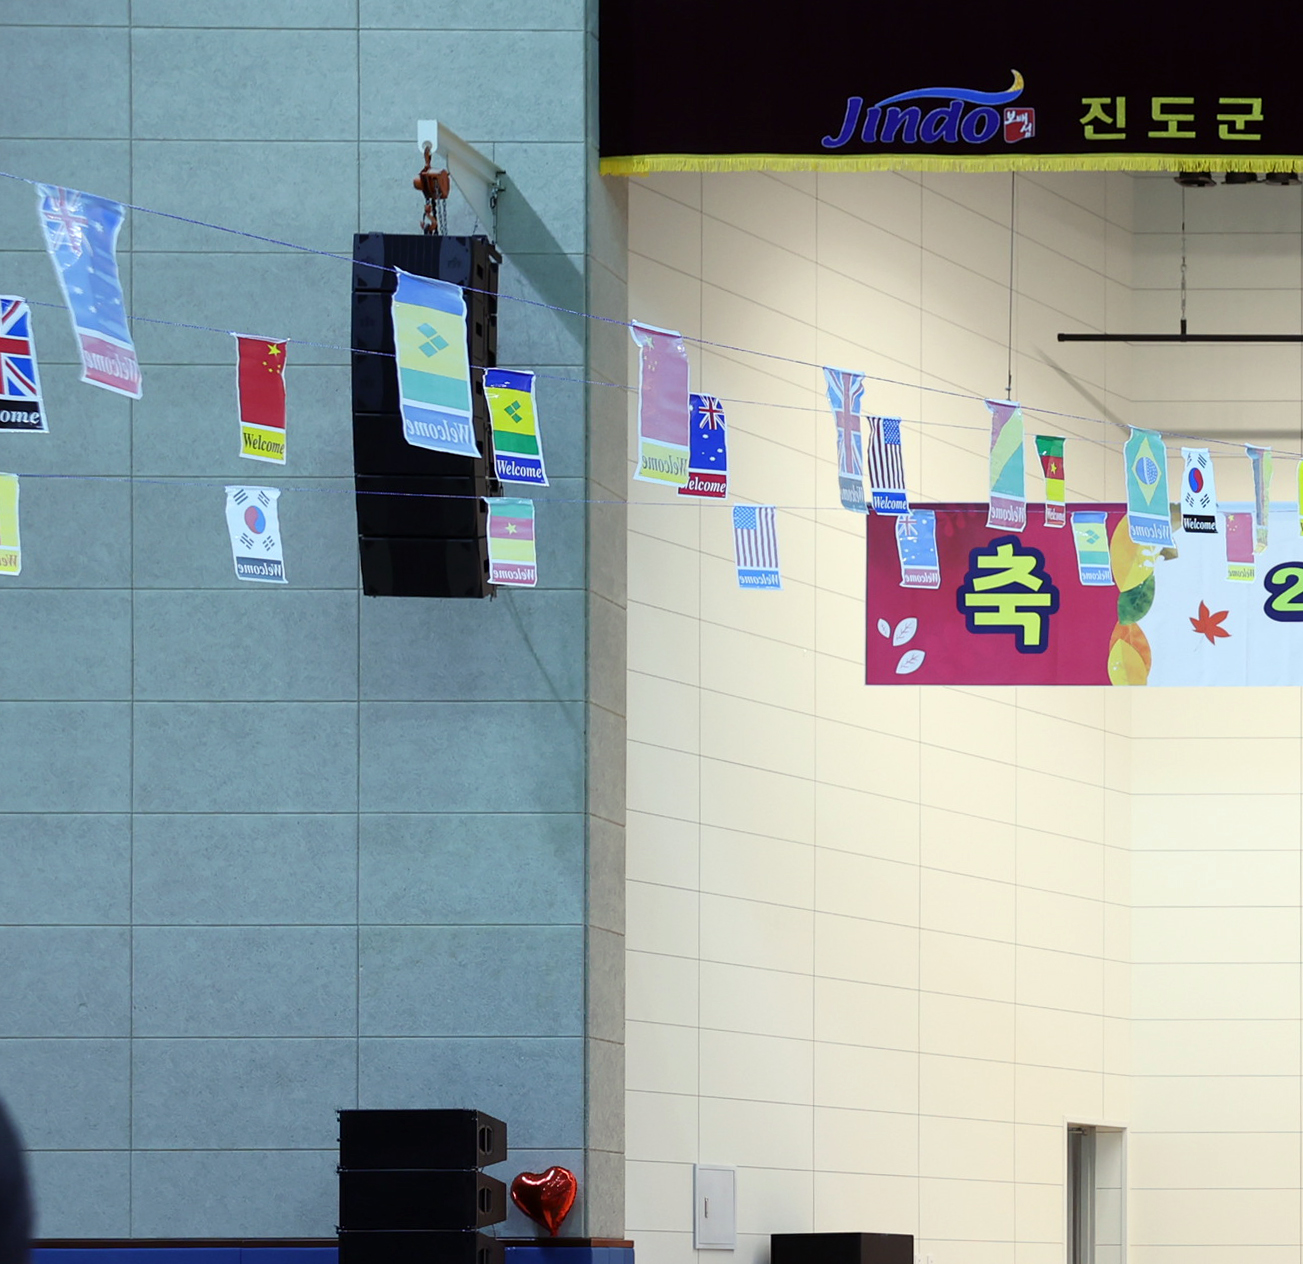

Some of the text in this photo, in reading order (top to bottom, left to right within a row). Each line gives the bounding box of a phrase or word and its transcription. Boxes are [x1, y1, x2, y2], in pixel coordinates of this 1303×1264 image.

[821, 96, 1001, 148] Jindo
[1079, 96, 1264, 141] 진도군
[243, 432, 285, 455] Welcome
[497, 460, 543, 478] Welcome
[874, 496, 908, 509] Welcome
[1183, 516, 1216, 531] Welcome
[963, 542, 1054, 647] 축
